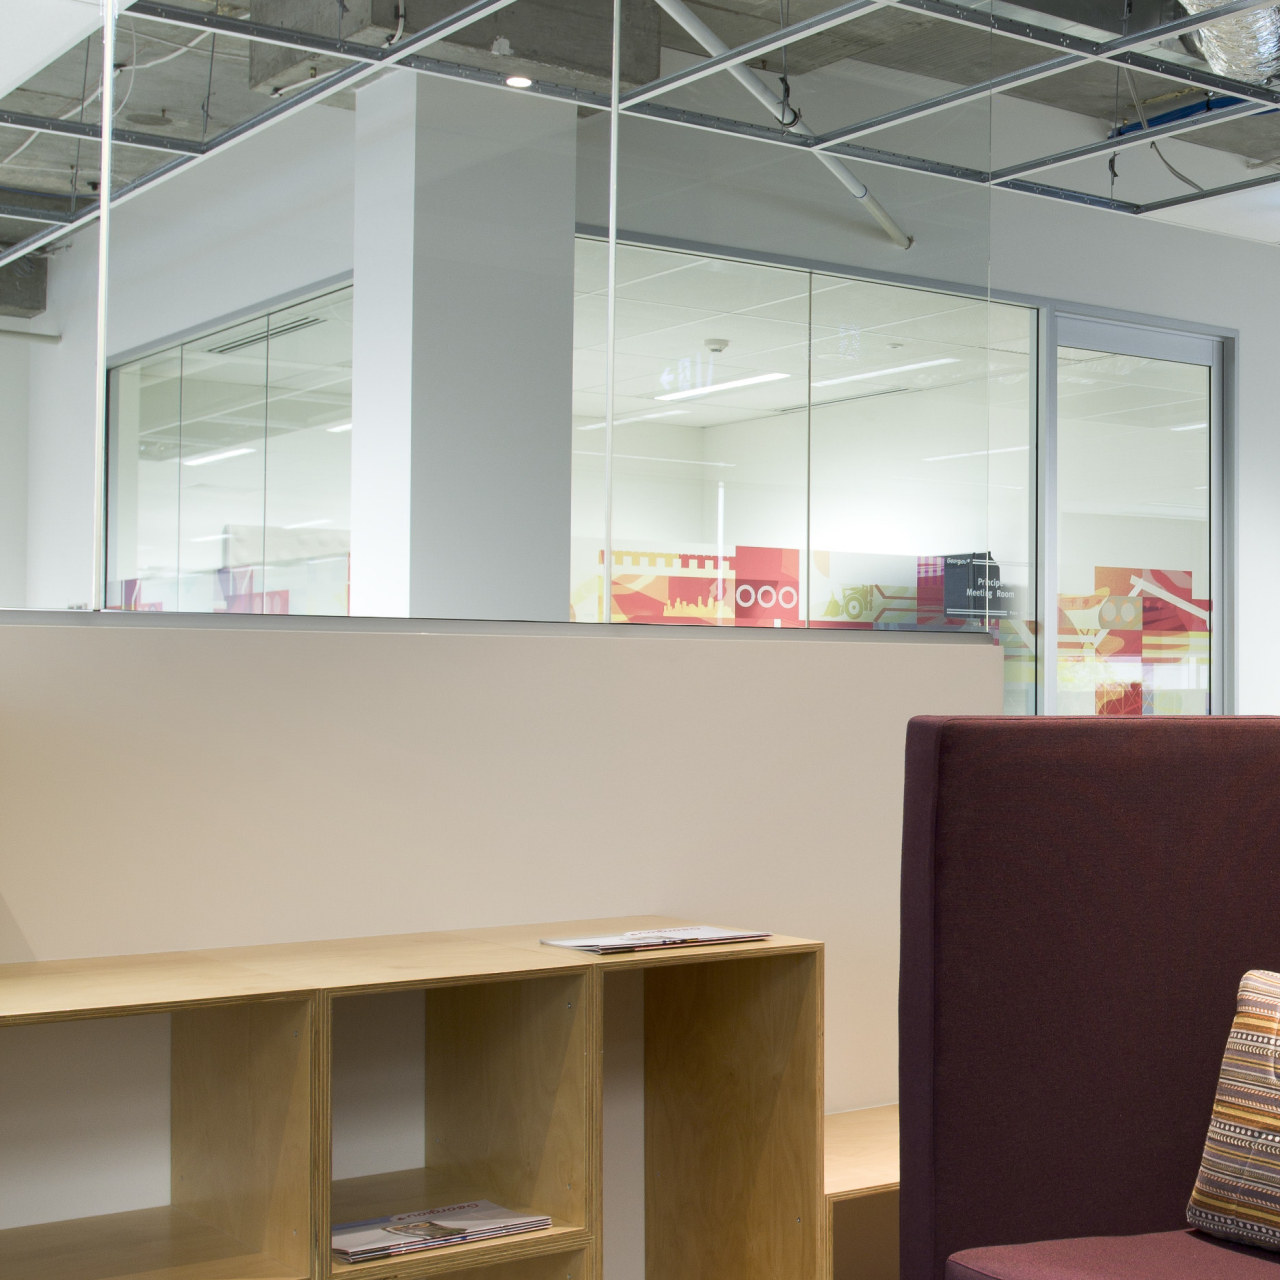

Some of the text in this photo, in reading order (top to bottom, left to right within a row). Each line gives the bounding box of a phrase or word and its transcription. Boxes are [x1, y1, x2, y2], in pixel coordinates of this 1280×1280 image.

[977, 577, 1004, 588] Princip
[967, 588, 1015, 599] Meetig Room
